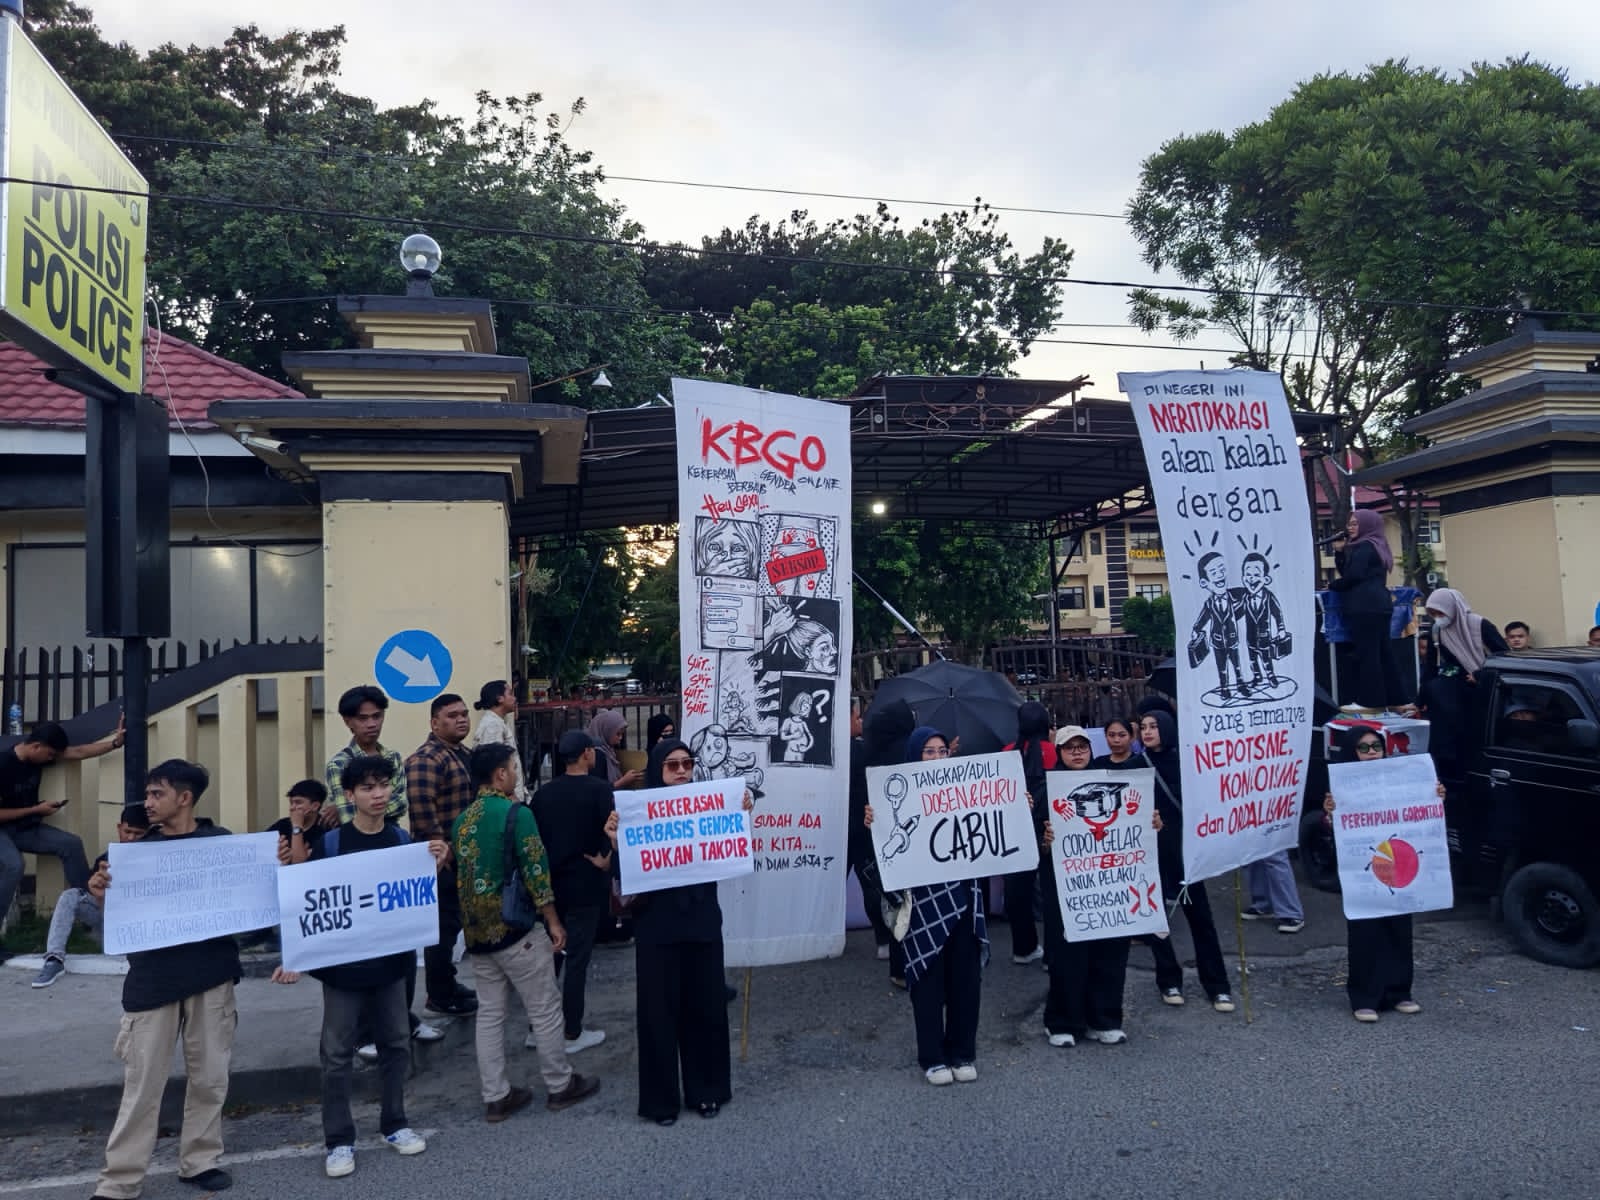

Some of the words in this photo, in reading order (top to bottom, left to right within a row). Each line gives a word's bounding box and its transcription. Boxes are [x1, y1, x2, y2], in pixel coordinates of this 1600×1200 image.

[32, 144, 130, 301] POLISI
[22, 227, 132, 379] POLICE
[1144, 385, 1159, 396] DI
[1164, 384, 1214, 395] NEGERI
[1224, 384, 1244, 397] INI
[1148, 400, 1270, 433] MERITOKRASI
[701, 416, 826, 479] KBGO
[1161, 438, 1215, 473] akan
[1218, 434, 1287, 470] kalah
[759, 469, 797, 495] GENDER
[1177, 486, 1282, 522] dengan
[647, 793, 725, 820] KEKERASAN
[754, 814, 792, 829] SUDAH
[798, 813, 821, 829] ADA
[1341, 809, 1400, 830] PEREMPUAN
[625, 820, 695, 847] BERBASIS
[698, 813, 744, 836] GENDER
[929, 810, 1020, 862] CABUL
[1197, 813, 1224, 838] dan
[640, 845, 693, 873] BUKAN
[699, 837, 749, 862] TAKDIR
[1062, 830, 1099, 857] COPOT
[1102, 825, 1143, 852] GELAR
[765, 856, 790, 871] DIAM
[377, 876, 437, 912] BANYAK
[1065, 873, 1097, 892] UNTUK
[1099, 866, 1138, 886] PELAKU
[304, 885, 352, 912] SATU
[1065, 890, 1131, 912] KEKERASAN
[299, 908, 353, 938] KASUS
[1074, 908, 1137, 931] SEXUAL
